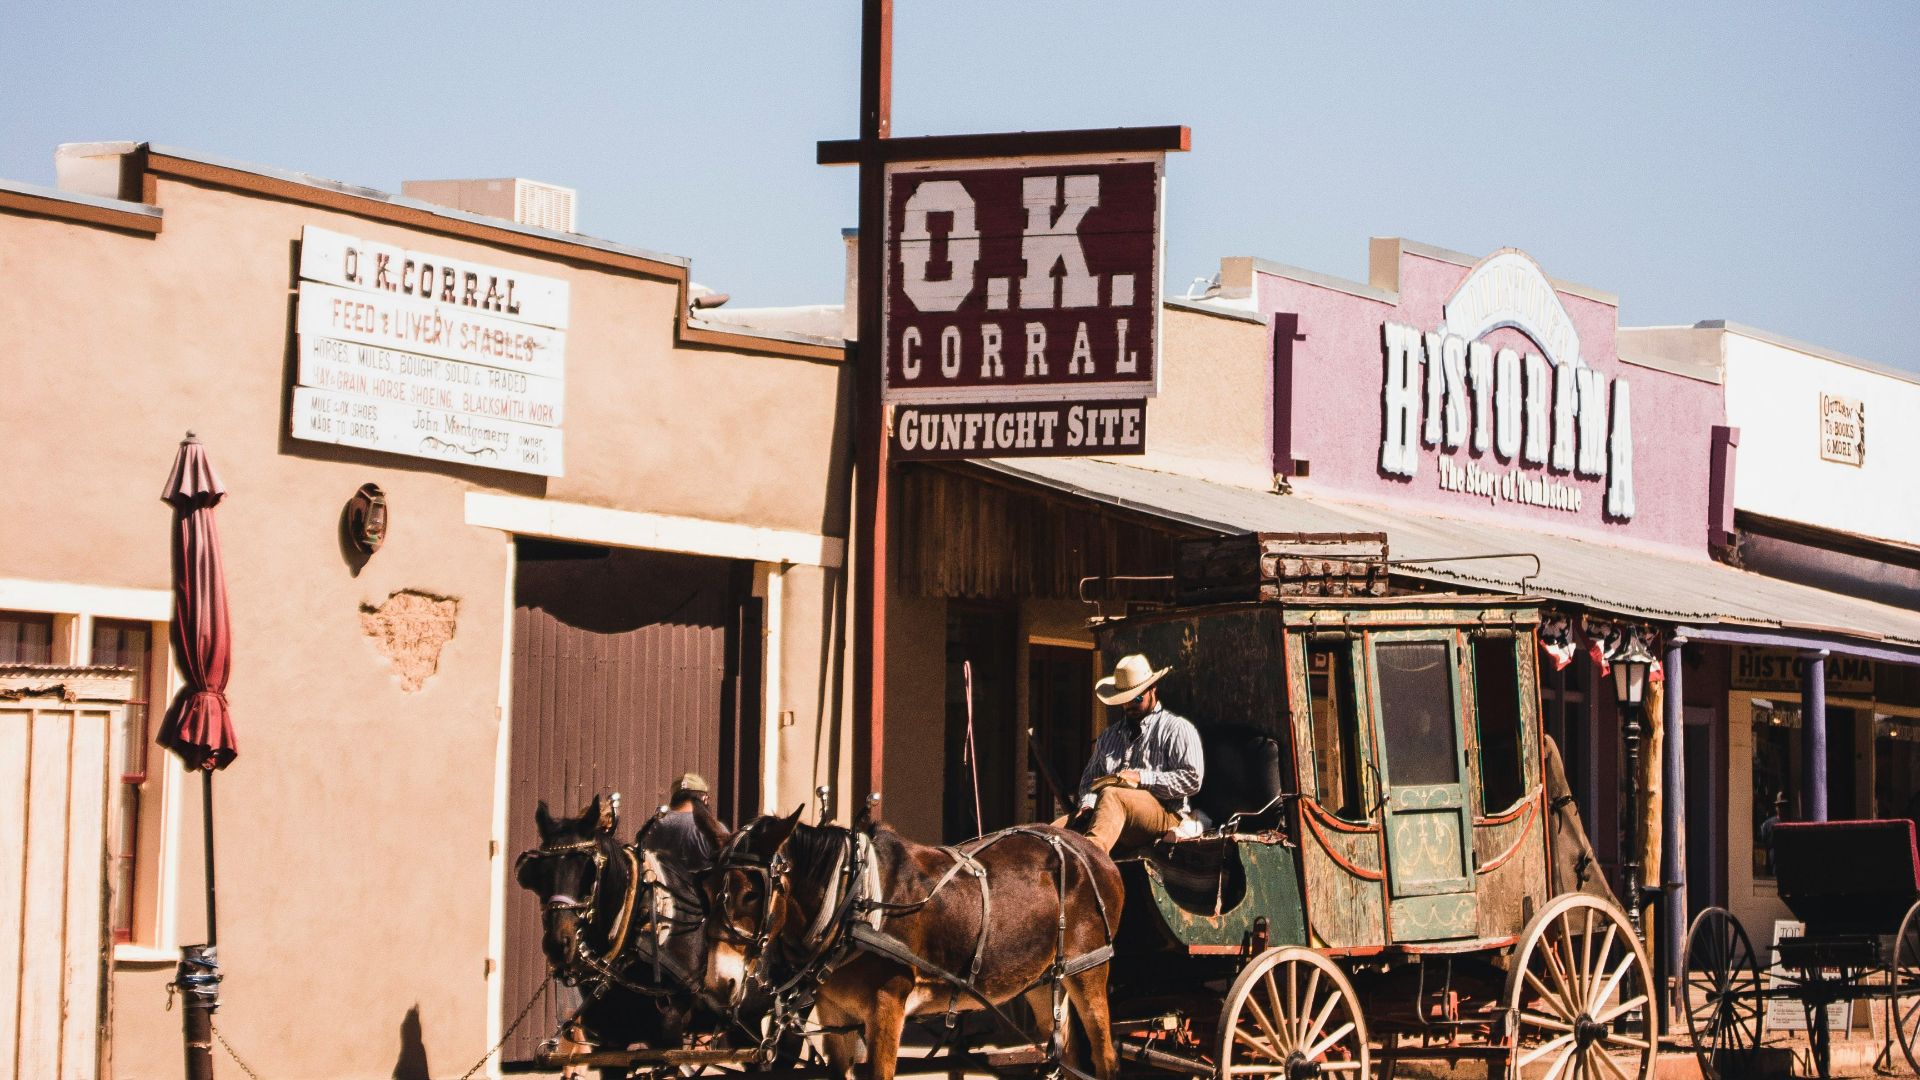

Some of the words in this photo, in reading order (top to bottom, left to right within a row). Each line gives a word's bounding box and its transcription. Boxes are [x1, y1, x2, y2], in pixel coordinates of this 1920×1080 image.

[331, 299, 375, 334] FEED
[395, 308, 454, 346] LIVERY
[460, 322, 536, 361] STABLES
[902, 318, 1137, 381] CORRAL
[488, 370, 527, 394] TRADED
[311, 395, 332, 413] MULE
[340, 400, 349, 416] OX
[351, 402, 379, 421] SHOES
[372, 378, 406, 402] HORSE
[462, 392, 525, 421] BLACKSMITH
[529, 401, 555, 422] WORK
[310, 415, 332, 433] MADE
[335, 419, 346, 435] TO
[412, 409, 439, 434] John
[444, 413, 511, 450] Montgomery
[899, 408, 1059, 451] GUNFIGHT
[1066, 404, 1141, 447] SITE
[1381, 320, 1635, 520] HISTORAMA
[522, 450, 540, 465] 1881
[1832, 439, 1852, 457] MORE
[1438, 453, 1465, 492] The
[1466, 460, 1500, 504] Story
[1502, 469, 1517, 501] of
[1516, 470, 1582, 513] Tombstone
[1428, 609, 1454, 620] STAGE
[1739, 655, 1872, 682] HISTOAMA
